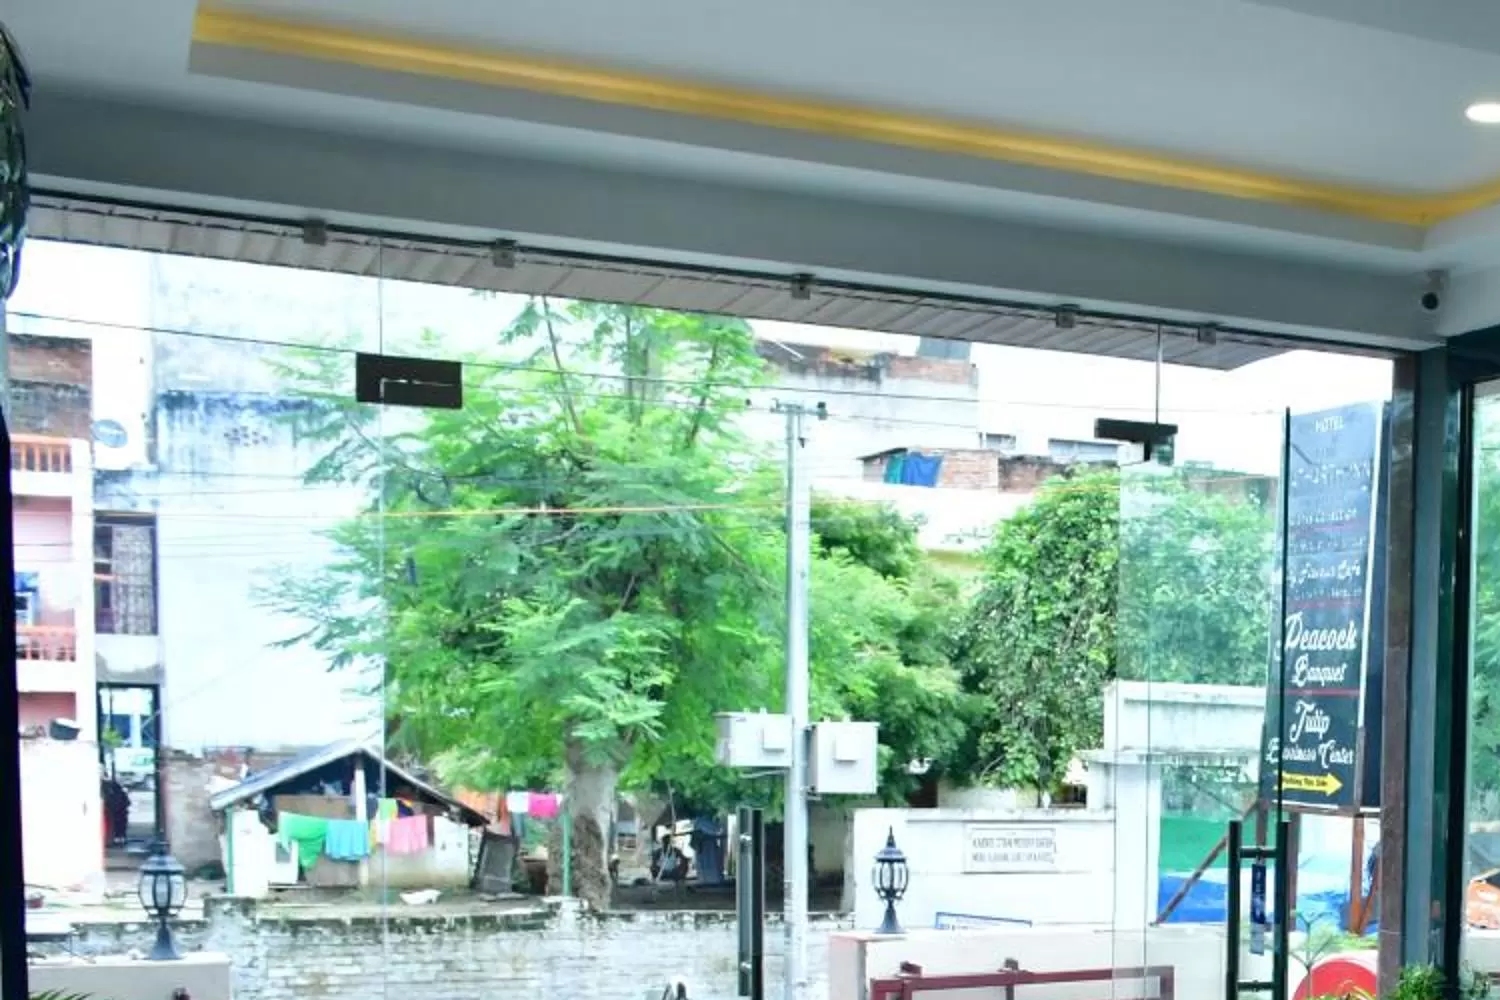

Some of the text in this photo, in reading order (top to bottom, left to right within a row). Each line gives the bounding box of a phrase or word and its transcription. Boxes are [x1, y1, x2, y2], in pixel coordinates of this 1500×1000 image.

[1284, 611, 1357, 652] Peacock
[1291, 653, 1347, 687] Banquet
[1289, 700, 1331, 743] Tulip
[1318, 739, 1354, 768] Center
